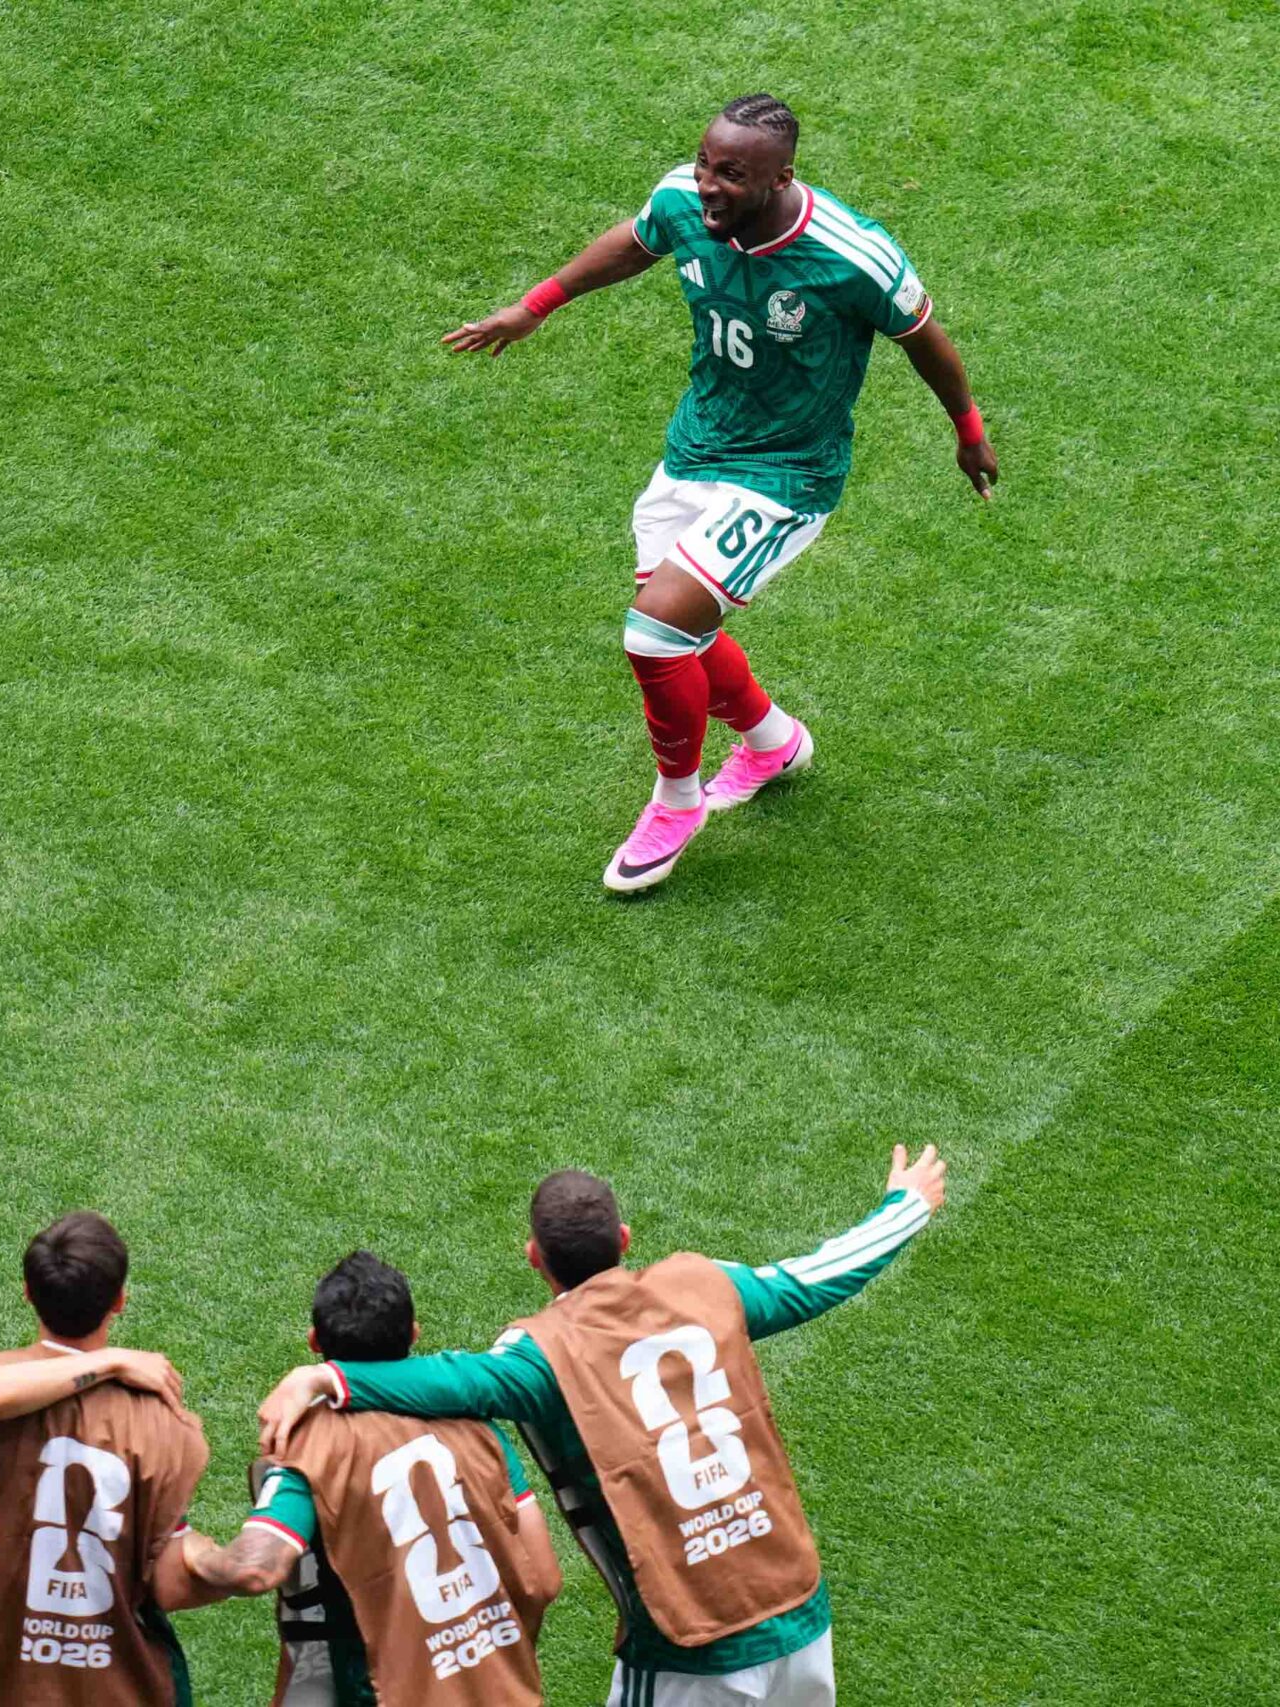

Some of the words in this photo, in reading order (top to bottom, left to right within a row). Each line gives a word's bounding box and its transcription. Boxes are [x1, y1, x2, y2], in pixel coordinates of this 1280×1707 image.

[708, 309, 754, 369] 16
[704, 497, 763, 559] 16
[694, 1461, 728, 1490] FIFA
[678, 1504, 735, 1538] WORLD
[734, 1490, 764, 1514] CUP
[684, 1510, 773, 1566] 2026
[438, 1572, 475, 1602] FIA
[23, 1617, 80, 1639] ORLD
[80, 1624, 114, 1640] CUP
[425, 1616, 478, 1653] WORD
[477, 1601, 511, 1625] CUP
[431, 1620, 521, 1680] 2026
